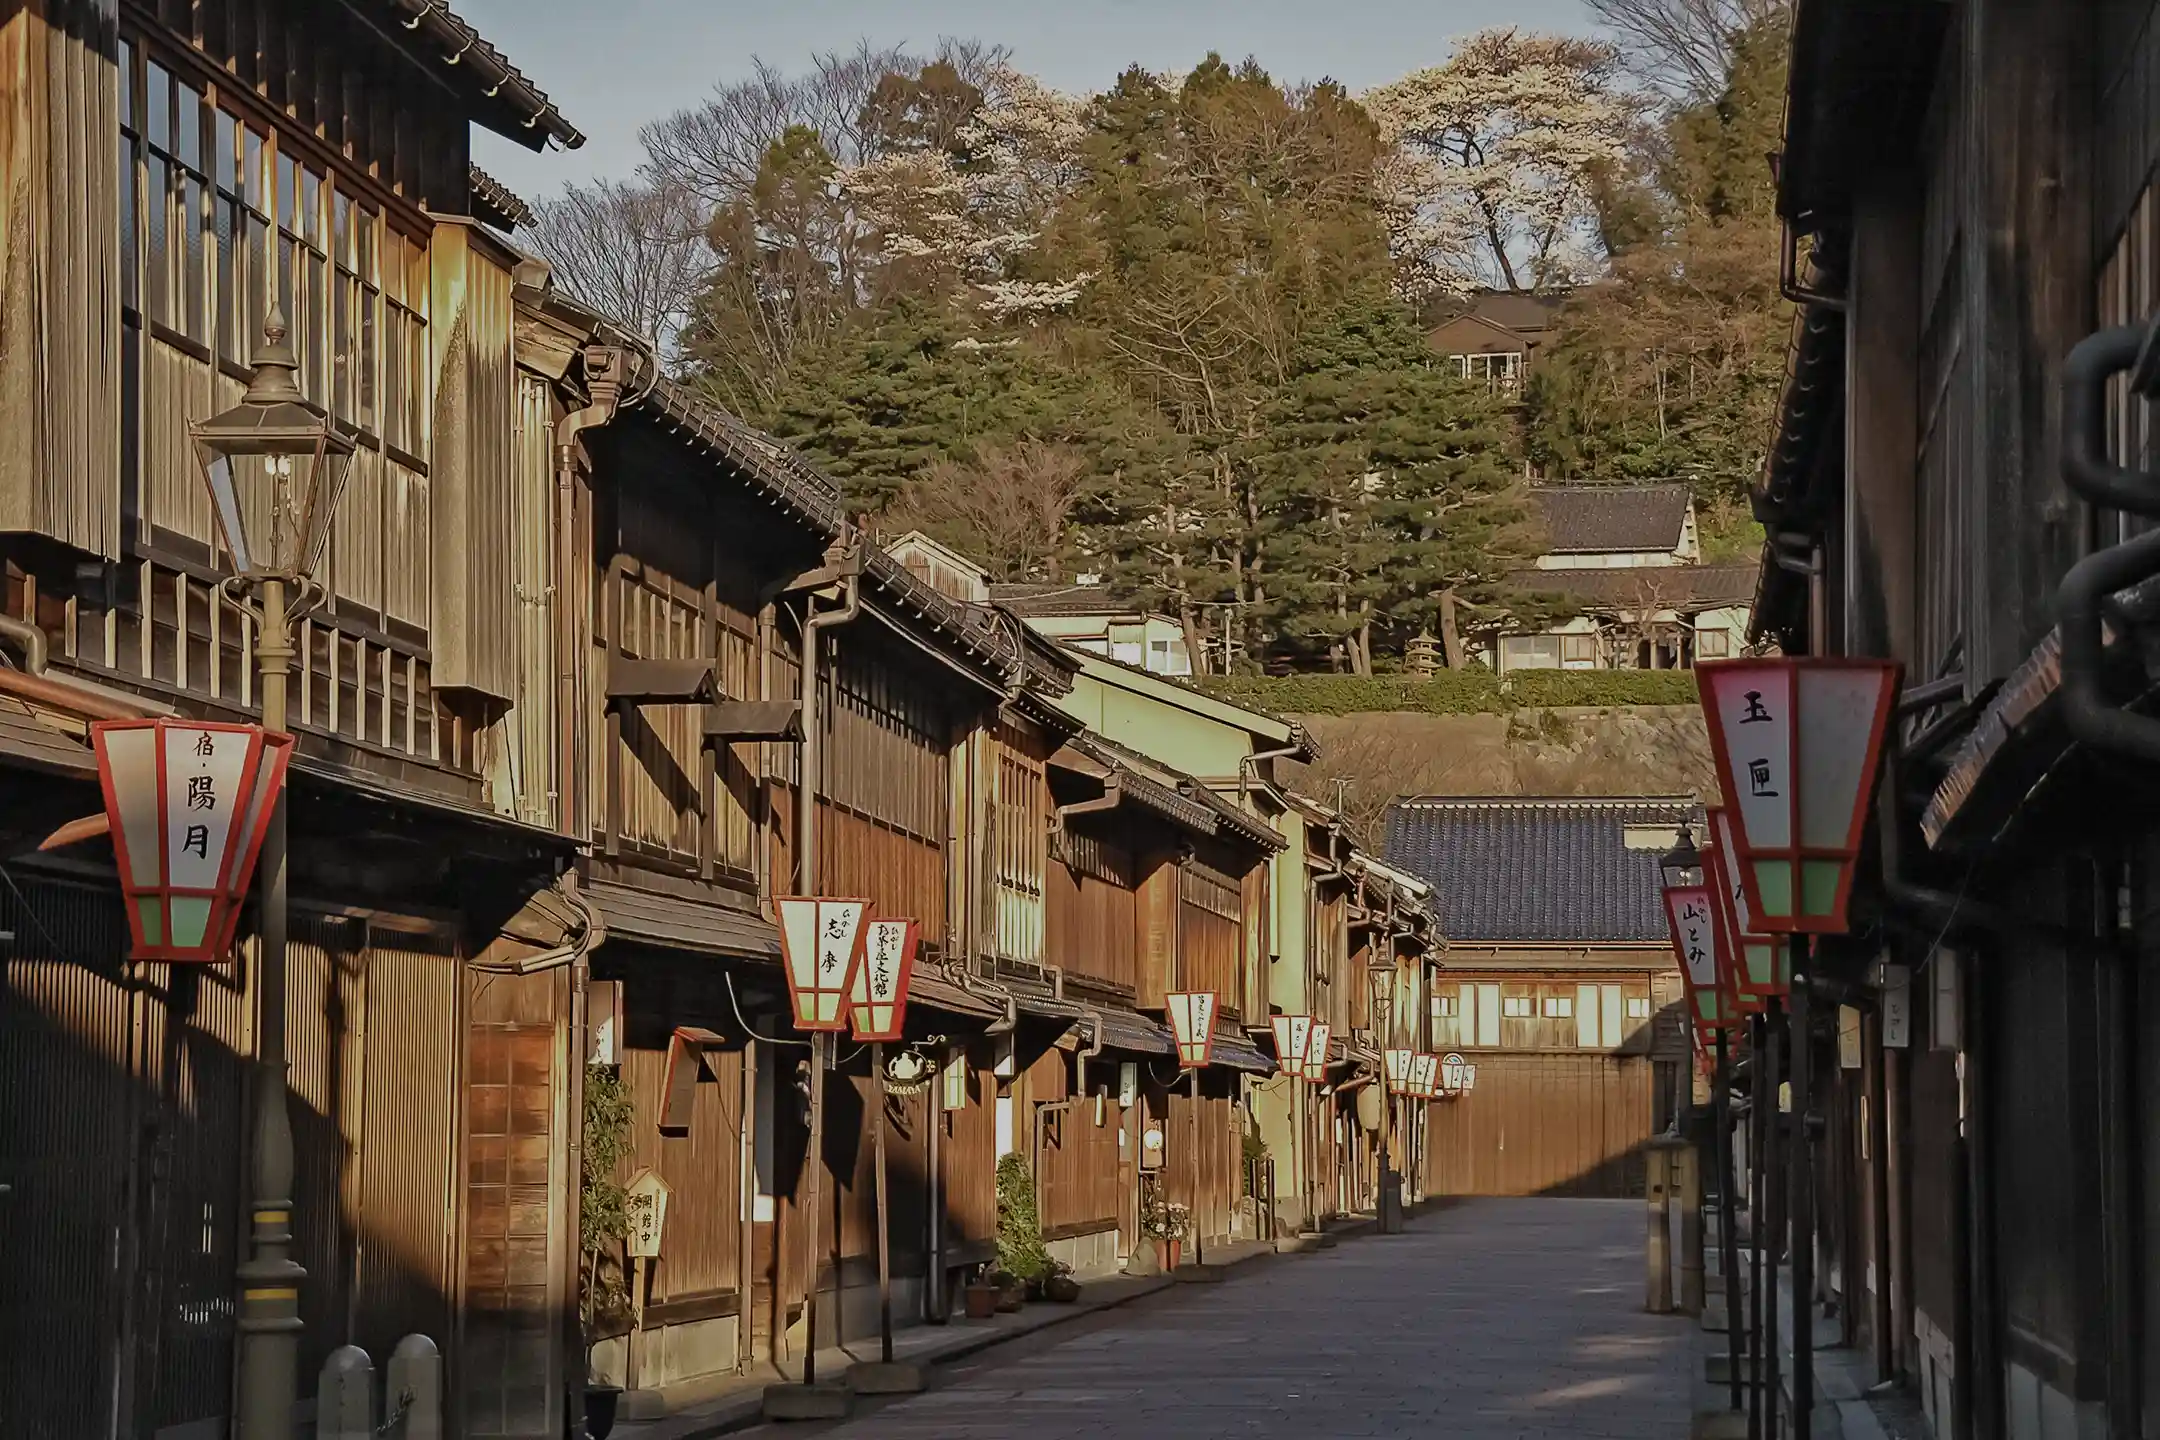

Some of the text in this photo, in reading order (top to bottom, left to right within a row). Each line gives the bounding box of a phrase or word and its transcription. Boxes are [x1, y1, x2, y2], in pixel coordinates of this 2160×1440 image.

[1738, 688, 1780, 798] 玉匣
[181, 731, 216, 860] 宿・陽月
[873, 924, 890, 998] お茶屋文化館
[1683, 902, 1706, 965] 山とみ
